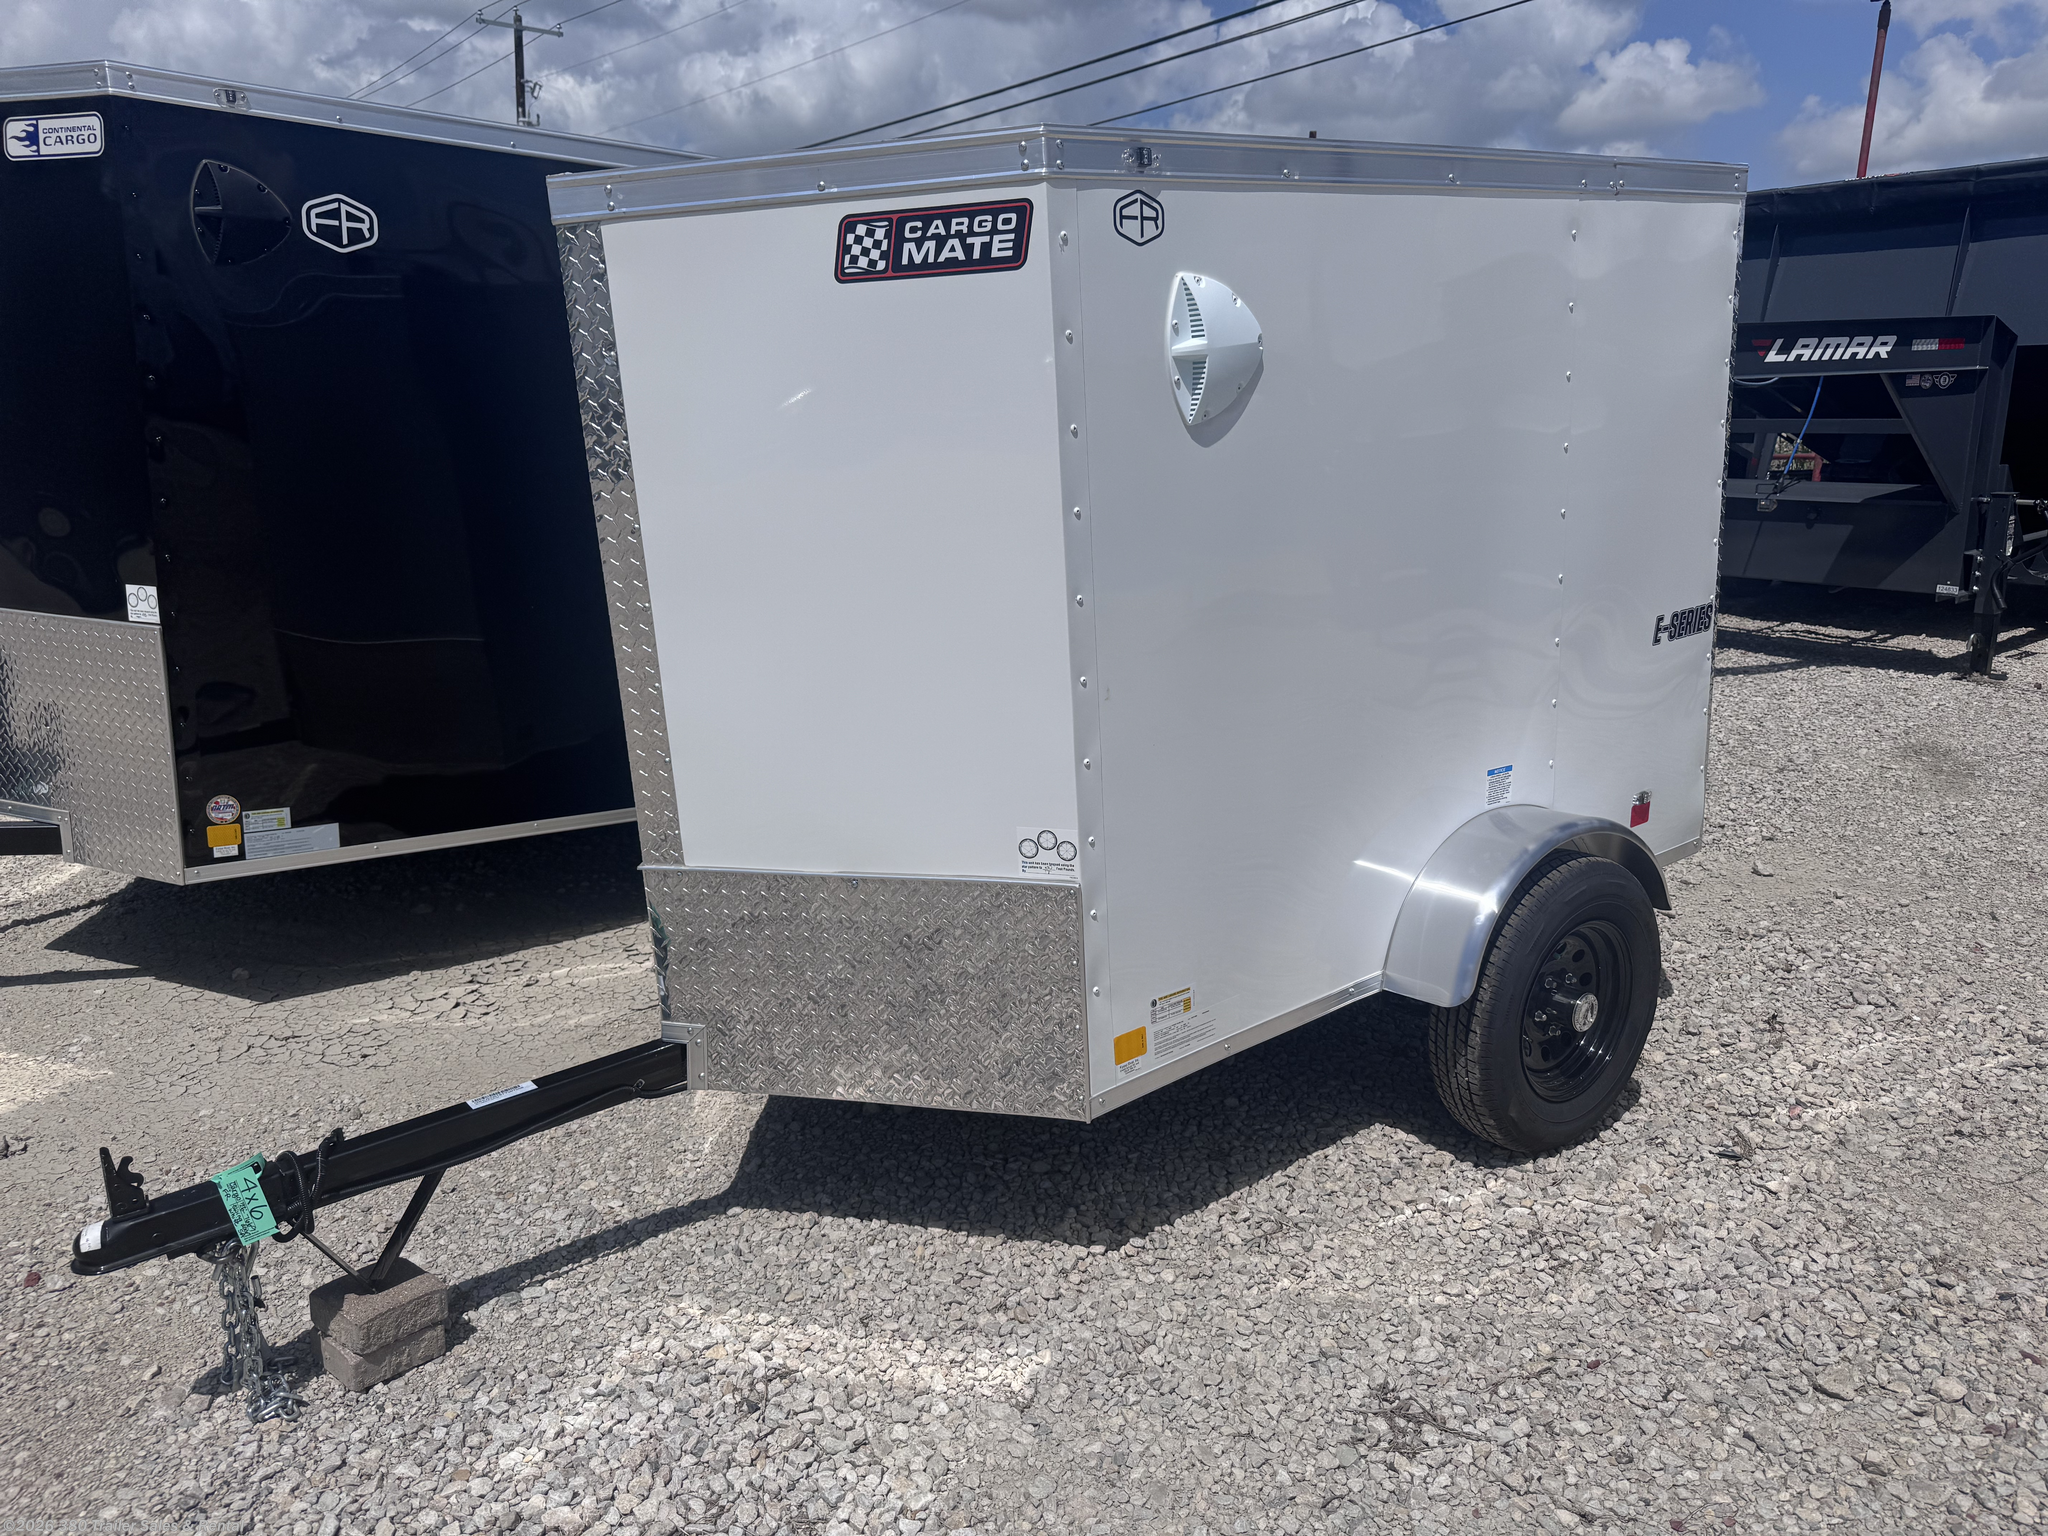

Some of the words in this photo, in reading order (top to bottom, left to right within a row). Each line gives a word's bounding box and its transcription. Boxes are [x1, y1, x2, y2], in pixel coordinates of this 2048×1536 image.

[42, 125, 96, 134] CONTINENTAL
[43, 133, 97, 146] CARGO
[904, 213, 1017, 239] CARGO
[901, 233, 1015, 266] MATE
[1764, 335, 1897, 362] LAMAR
[1652, 602, 1713, 646] E-SERIES
